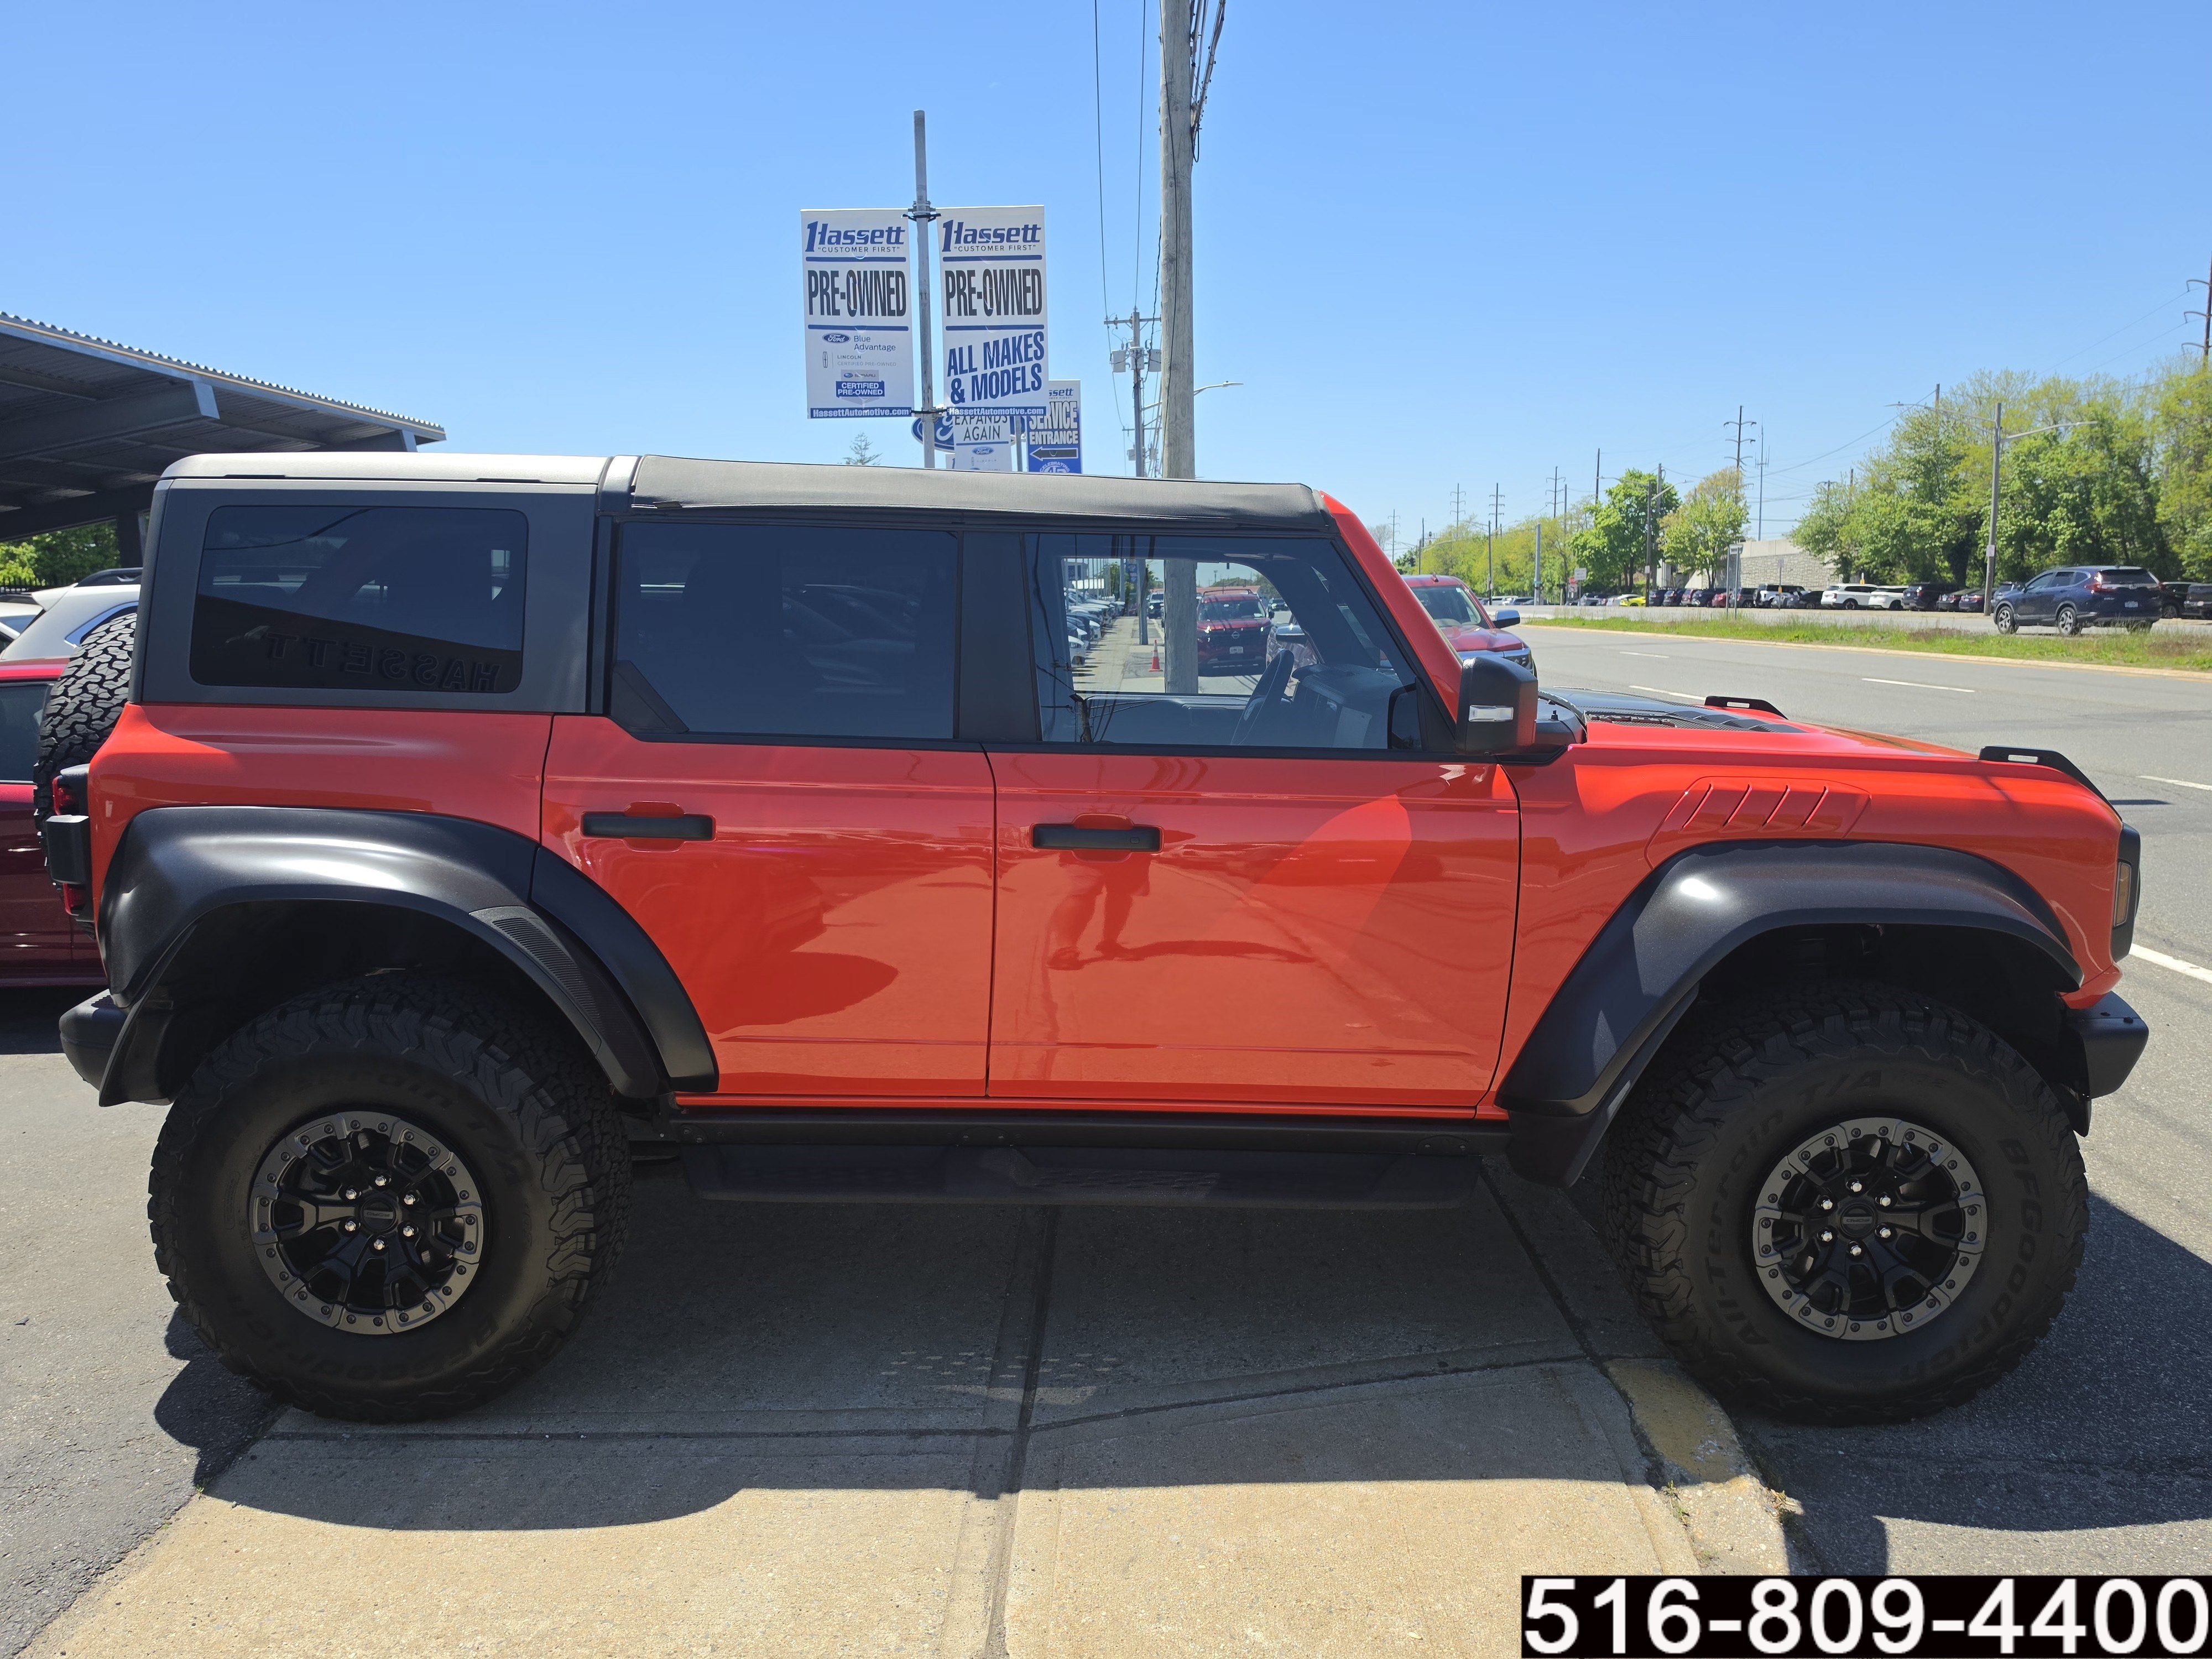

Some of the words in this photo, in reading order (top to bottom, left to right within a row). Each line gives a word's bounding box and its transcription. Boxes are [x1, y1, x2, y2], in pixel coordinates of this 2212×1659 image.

[807, 270, 906, 317] PRE-OWNED
[945, 269, 1042, 316] PRE-OWNED
[827, 335, 846, 343] Ford
[854, 343, 896, 352] Advantage
[947, 345, 978, 377] ALL
[983, 331, 1045, 370] MAKES
[951, 378, 966, 404] &
[972, 363, 1042, 401] MODELS
[813, 408, 909, 418] HassettAutomotive.com
[963, 425, 1000, 441] AGAIN
[1030, 431, 1079, 445] ENTRANCE
